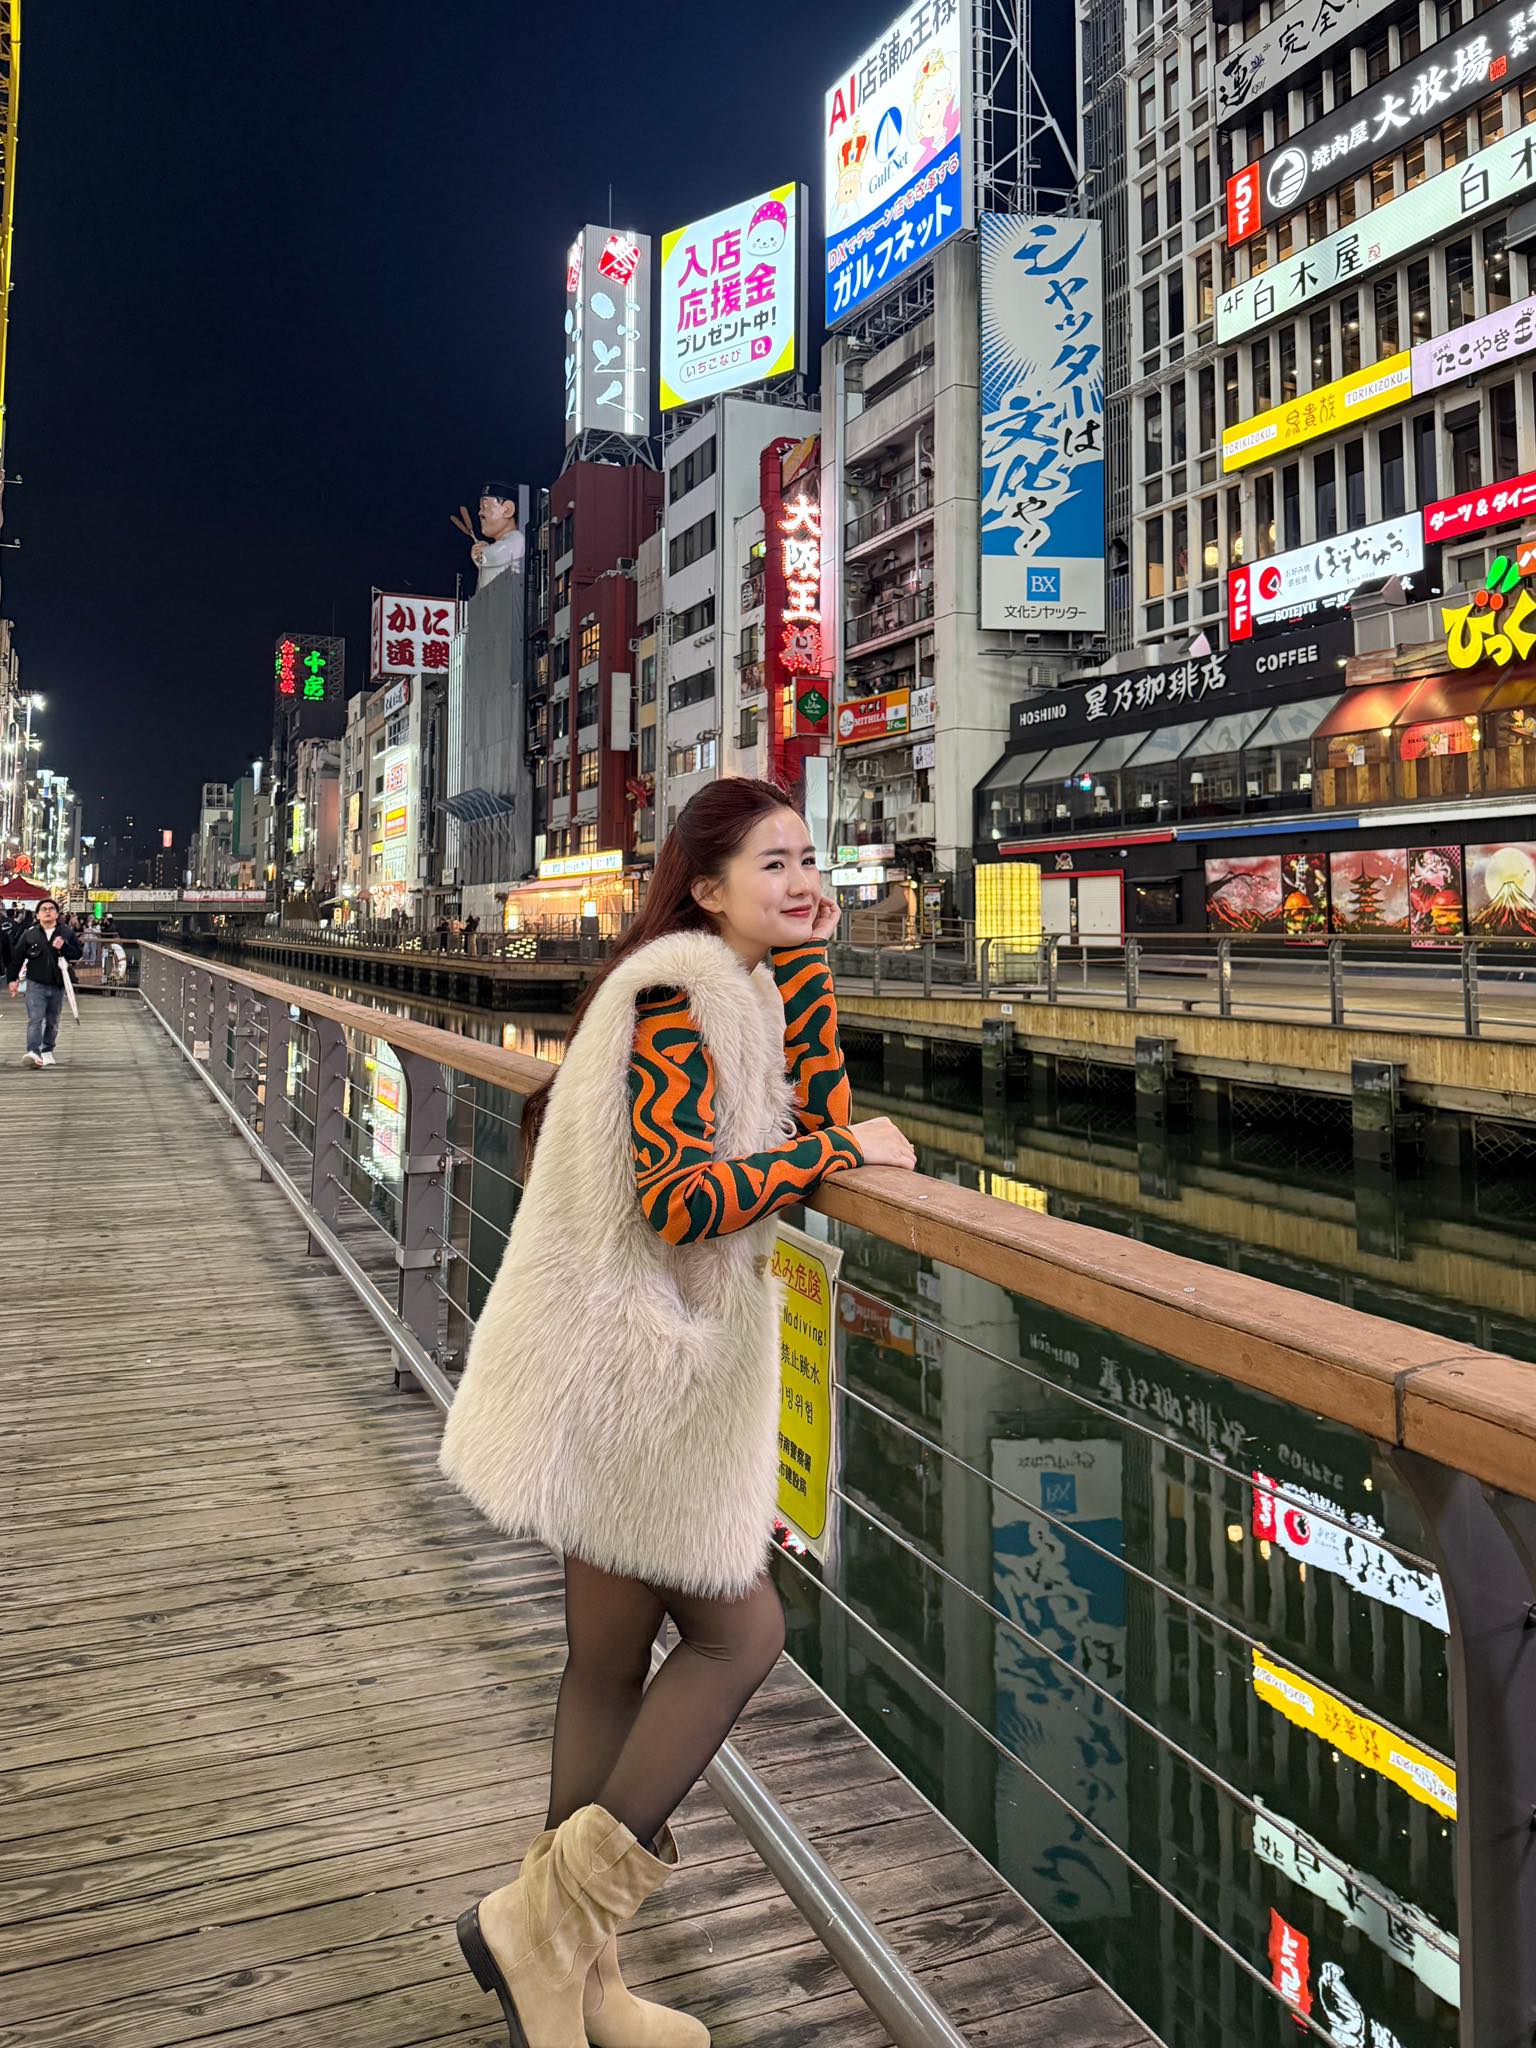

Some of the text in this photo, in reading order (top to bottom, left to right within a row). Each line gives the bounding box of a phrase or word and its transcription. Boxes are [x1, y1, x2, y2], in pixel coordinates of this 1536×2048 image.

[1279, 0, 1360, 65] 完全
[1311, 36, 1492, 172] 焼肉屋 大牧場
[1236, 175, 1251, 235] 5F
[678, 228, 741, 288] 入店
[833, 193, 953, 312] ガルフネット
[1223, 233, 1363, 321] 4F 白木屋
[676, 262, 777, 334] 応援金
[1436, 317, 1536, 376] たこやき王
[1347, 372, 1403, 404] TORIKIZOKU
[1225, 431, 1271, 455] TORIKIZOKU
[1476, 498, 1488, 516] &
[1030, 575, 1057, 593] BX
[1235, 578, 1248, 630] 2F
[386, 603, 450, 636] かに
[1004, 604, 1087, 620] 文化シャッター
[1256, 645, 1318, 673] COFFEE
[1084, 653, 1228, 722] 星乃珈琲店
[854, 712, 886, 727] MITHILA
[1019, 703, 1067, 726] HOSHINO
